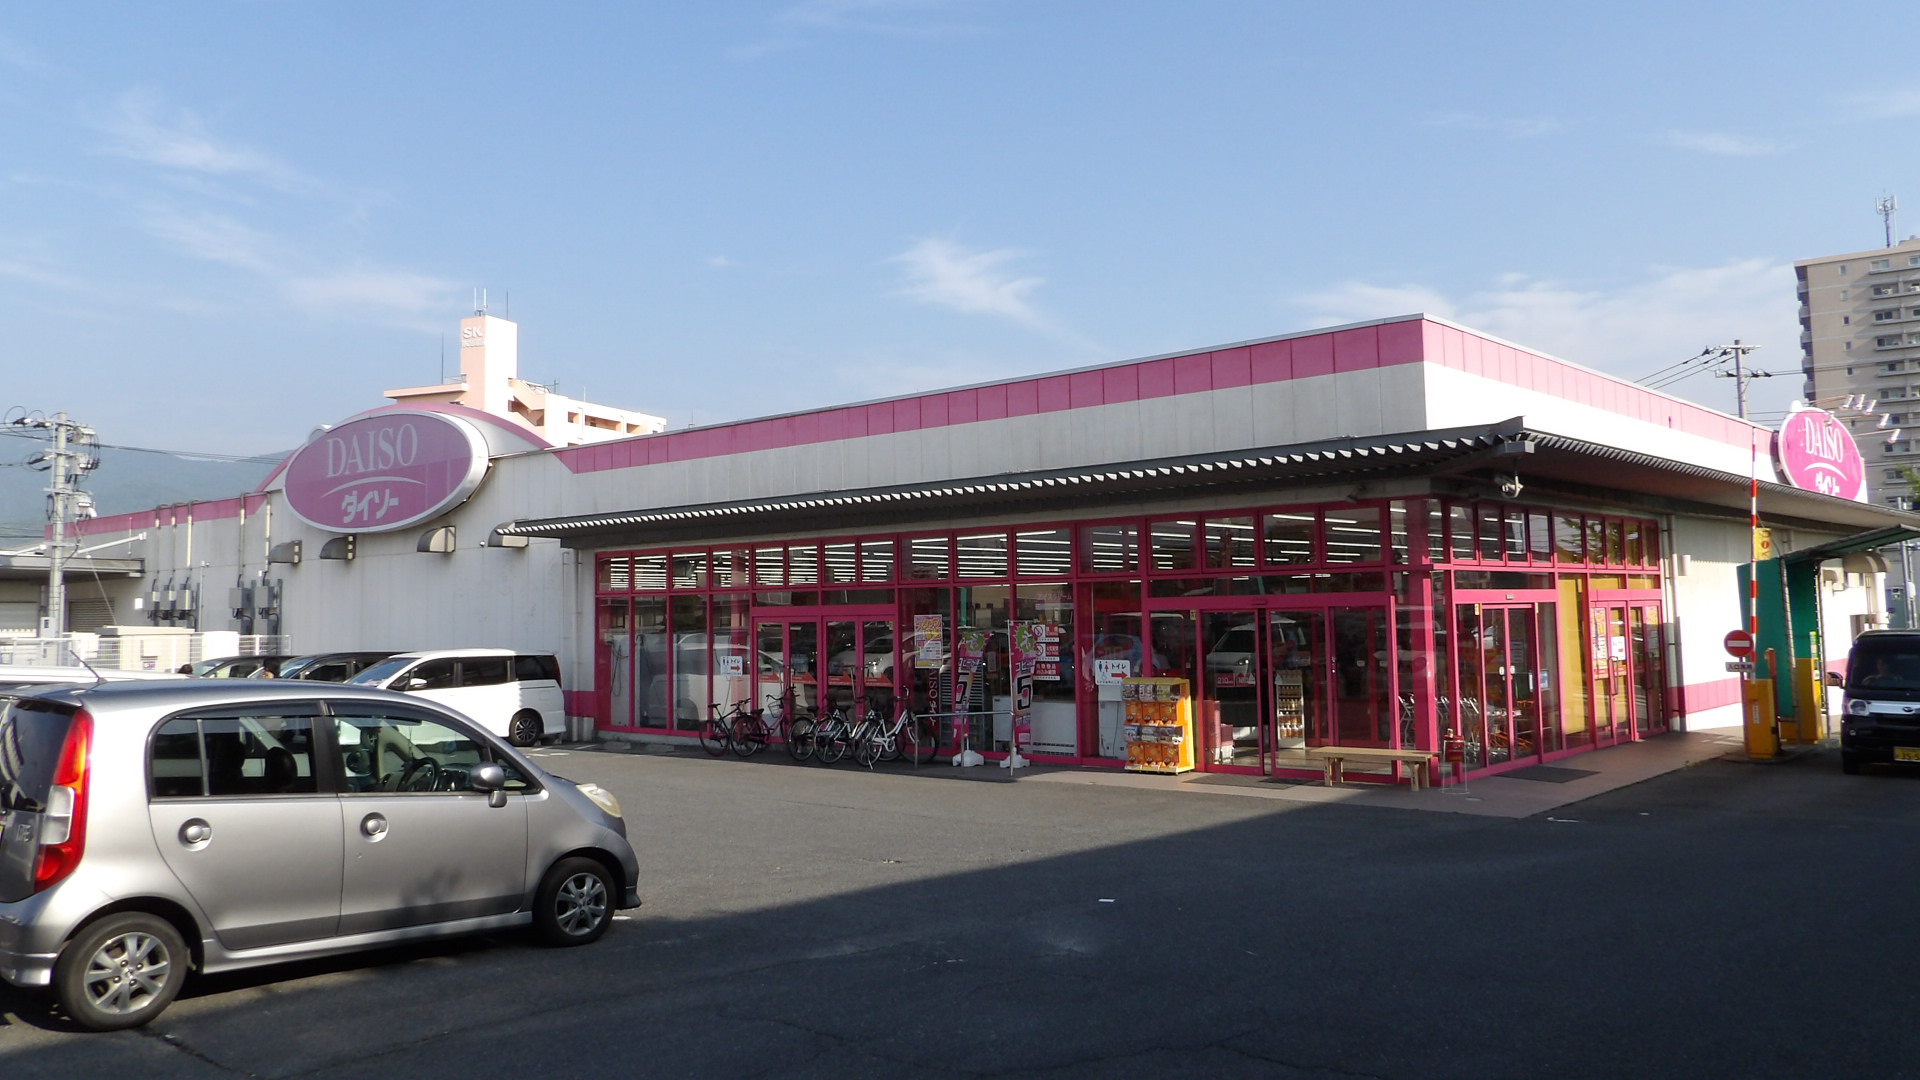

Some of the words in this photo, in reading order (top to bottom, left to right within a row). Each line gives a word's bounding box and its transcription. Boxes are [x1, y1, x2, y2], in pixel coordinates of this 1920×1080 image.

[463, 326, 482, 339] SK
[327, 423, 418, 478] DAISO
[1804, 416, 1843, 463] DAISO
[341, 488, 399, 523] ダイソー
[1111, 662, 1126, 670] トイレ
[1018, 674, 1031, 710] 5
